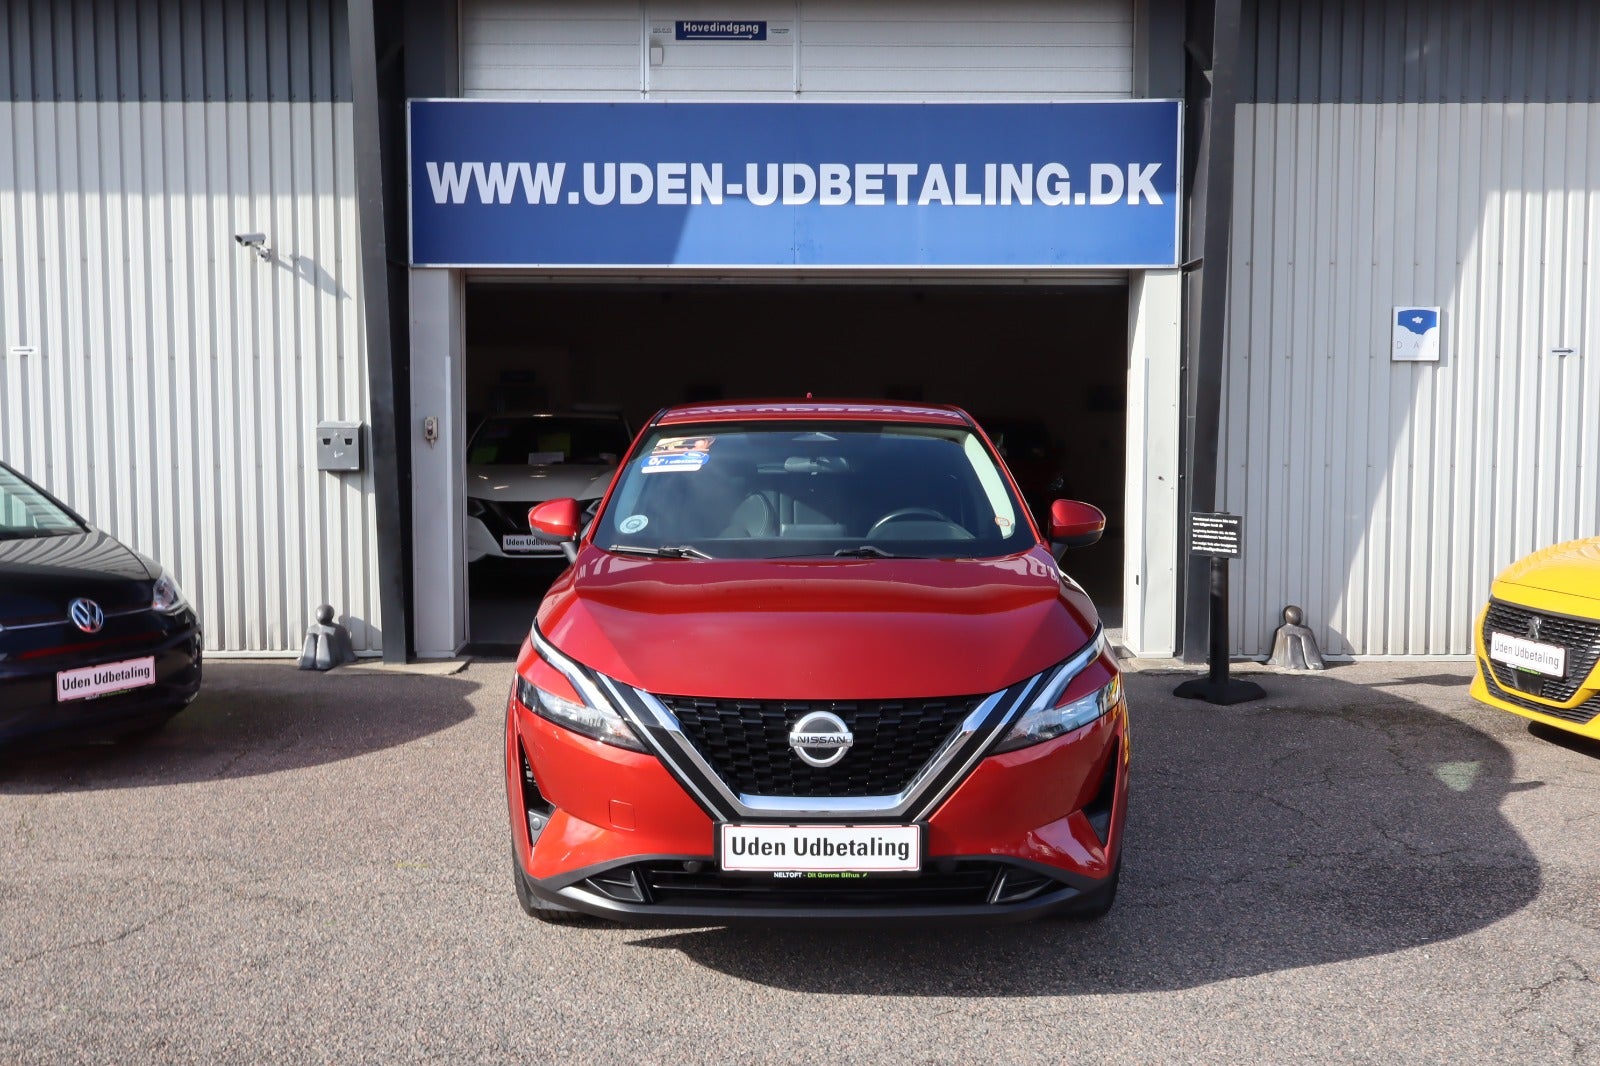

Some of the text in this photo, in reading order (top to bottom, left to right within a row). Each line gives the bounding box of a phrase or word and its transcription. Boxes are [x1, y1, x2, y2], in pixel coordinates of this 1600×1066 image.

[683, 22, 759, 34] Hovedindgang
[426, 162, 1164, 205] WWW.UDEN-UDBETALING.DK
[1494, 640, 1512, 654] Uden
[1514, 646, 1560, 669] Udbetaling
[62, 666, 150, 691] Uden Udbetaling
[797, 736, 846, 744] NISSAN
[732, 837, 909, 861] Uden Udbetaling
